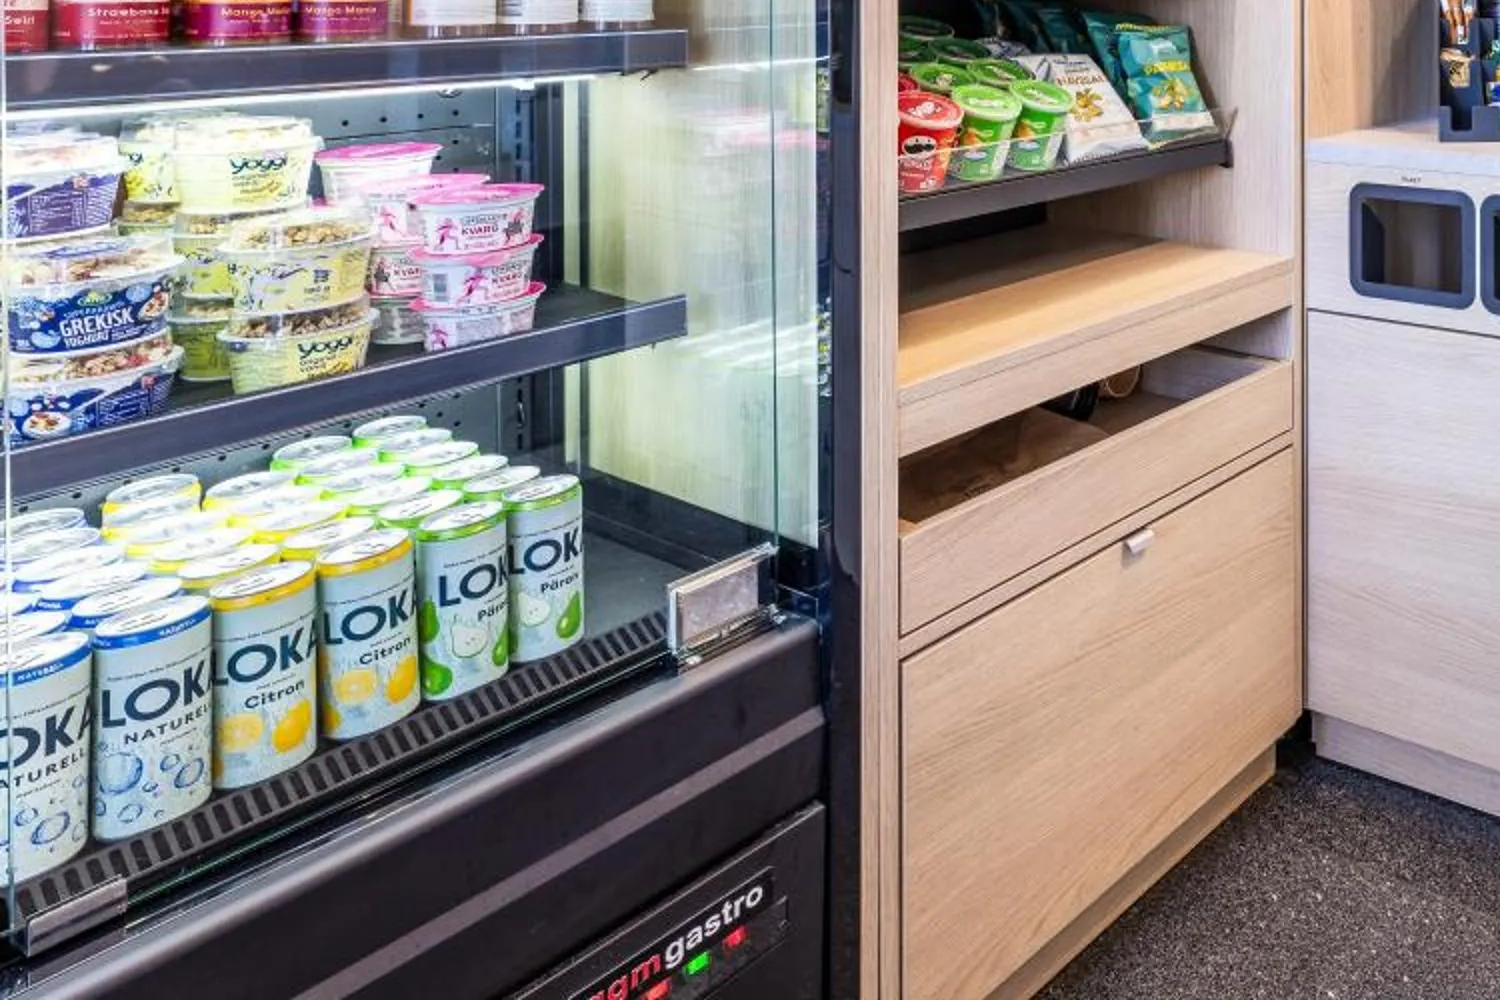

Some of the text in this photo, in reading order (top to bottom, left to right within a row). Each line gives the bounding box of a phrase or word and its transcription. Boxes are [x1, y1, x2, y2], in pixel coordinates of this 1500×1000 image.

[60, 307, 135, 338] GREKISK
[508, 526, 582, 575] LOK
[359, 636, 411, 665] Citron
[102, 655, 211, 728] LOK
[244, 679, 305, 709] Citron
[0, 692, 91, 771] OKA
